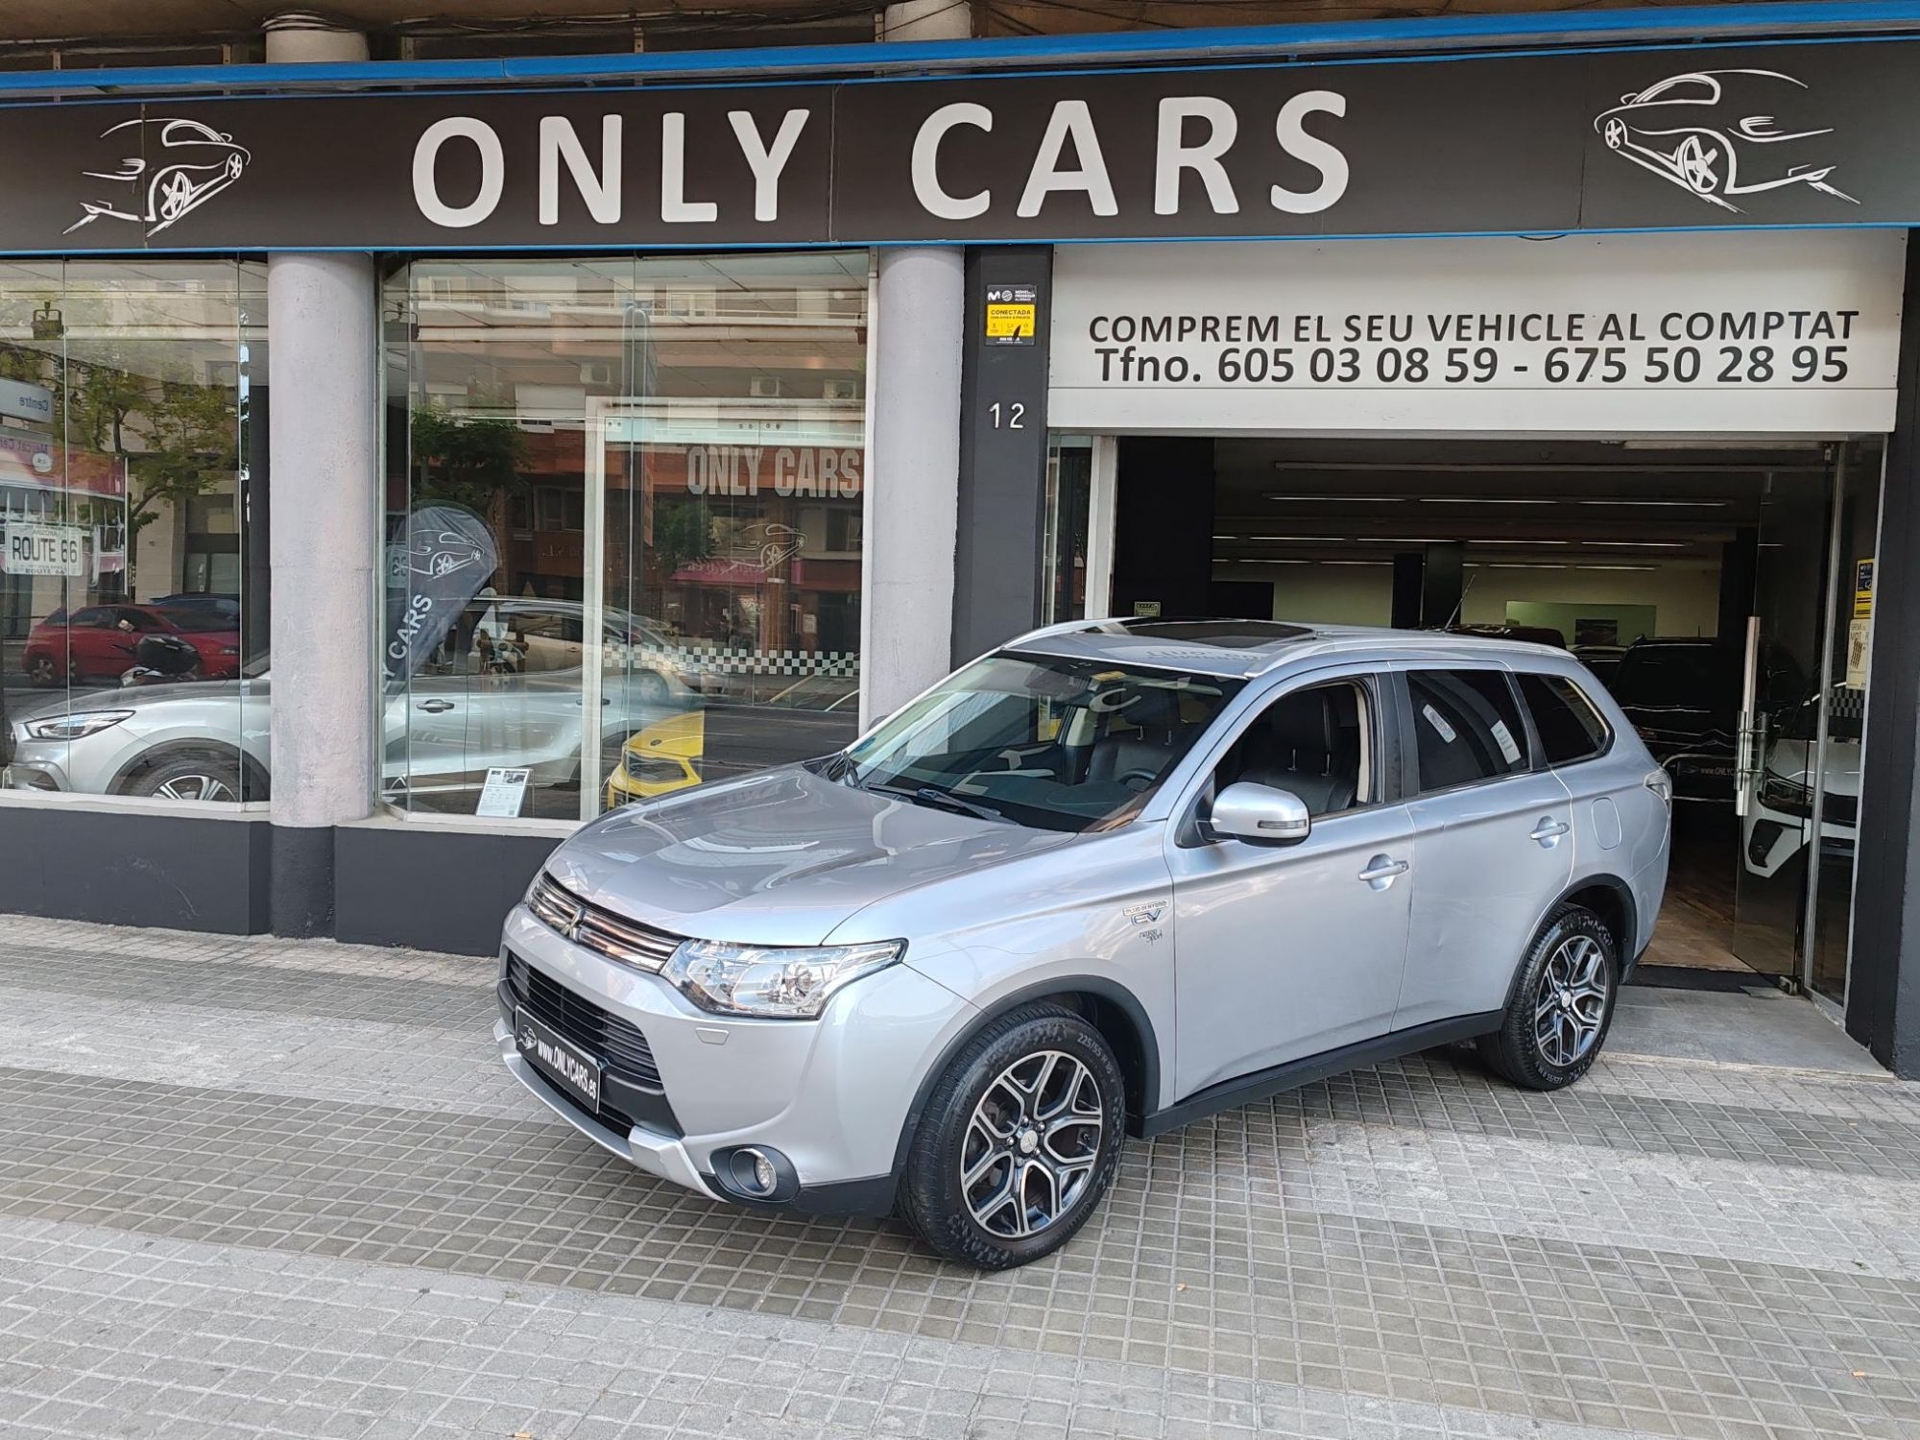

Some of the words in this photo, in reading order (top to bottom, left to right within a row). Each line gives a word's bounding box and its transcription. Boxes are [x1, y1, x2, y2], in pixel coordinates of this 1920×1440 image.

[413, 110, 809, 227] ONLY
[912, 91, 1348, 217] CARS
[1090, 316, 1278, 342] COMPREM
[1295, 316, 1330, 341] EL
[1344, 315, 1412, 342] SEU
[1428, 314, 1585, 341] VEHICLE
[1598, 314, 1645, 340] AL
[1661, 311, 1859, 340] COMPTAT
[1095, 346, 1200, 382] Tfno.
[1219, 348, 1293, 382] 605
[1310, 348, 1360, 382] 03
[1377, 348, 1428, 382] 08
[1446, 348, 1497, 382] 59
[1545, 347, 1626, 382] 675
[1645, 347, 1700, 382] 50
[1718, 346, 1773, 382] 28
[1792, 346, 1847, 382] 95
[989, 402, 1025, 429] 12
[688, 446, 764, 496] ONLY
[774, 447, 860, 499] CARS
[12, 535, 56, 562] ROUTE
[61, 539, 78, 563] 66
[388, 594, 433, 660] CARS
[537, 1038, 597, 1100] www.ONLYCARS.es
